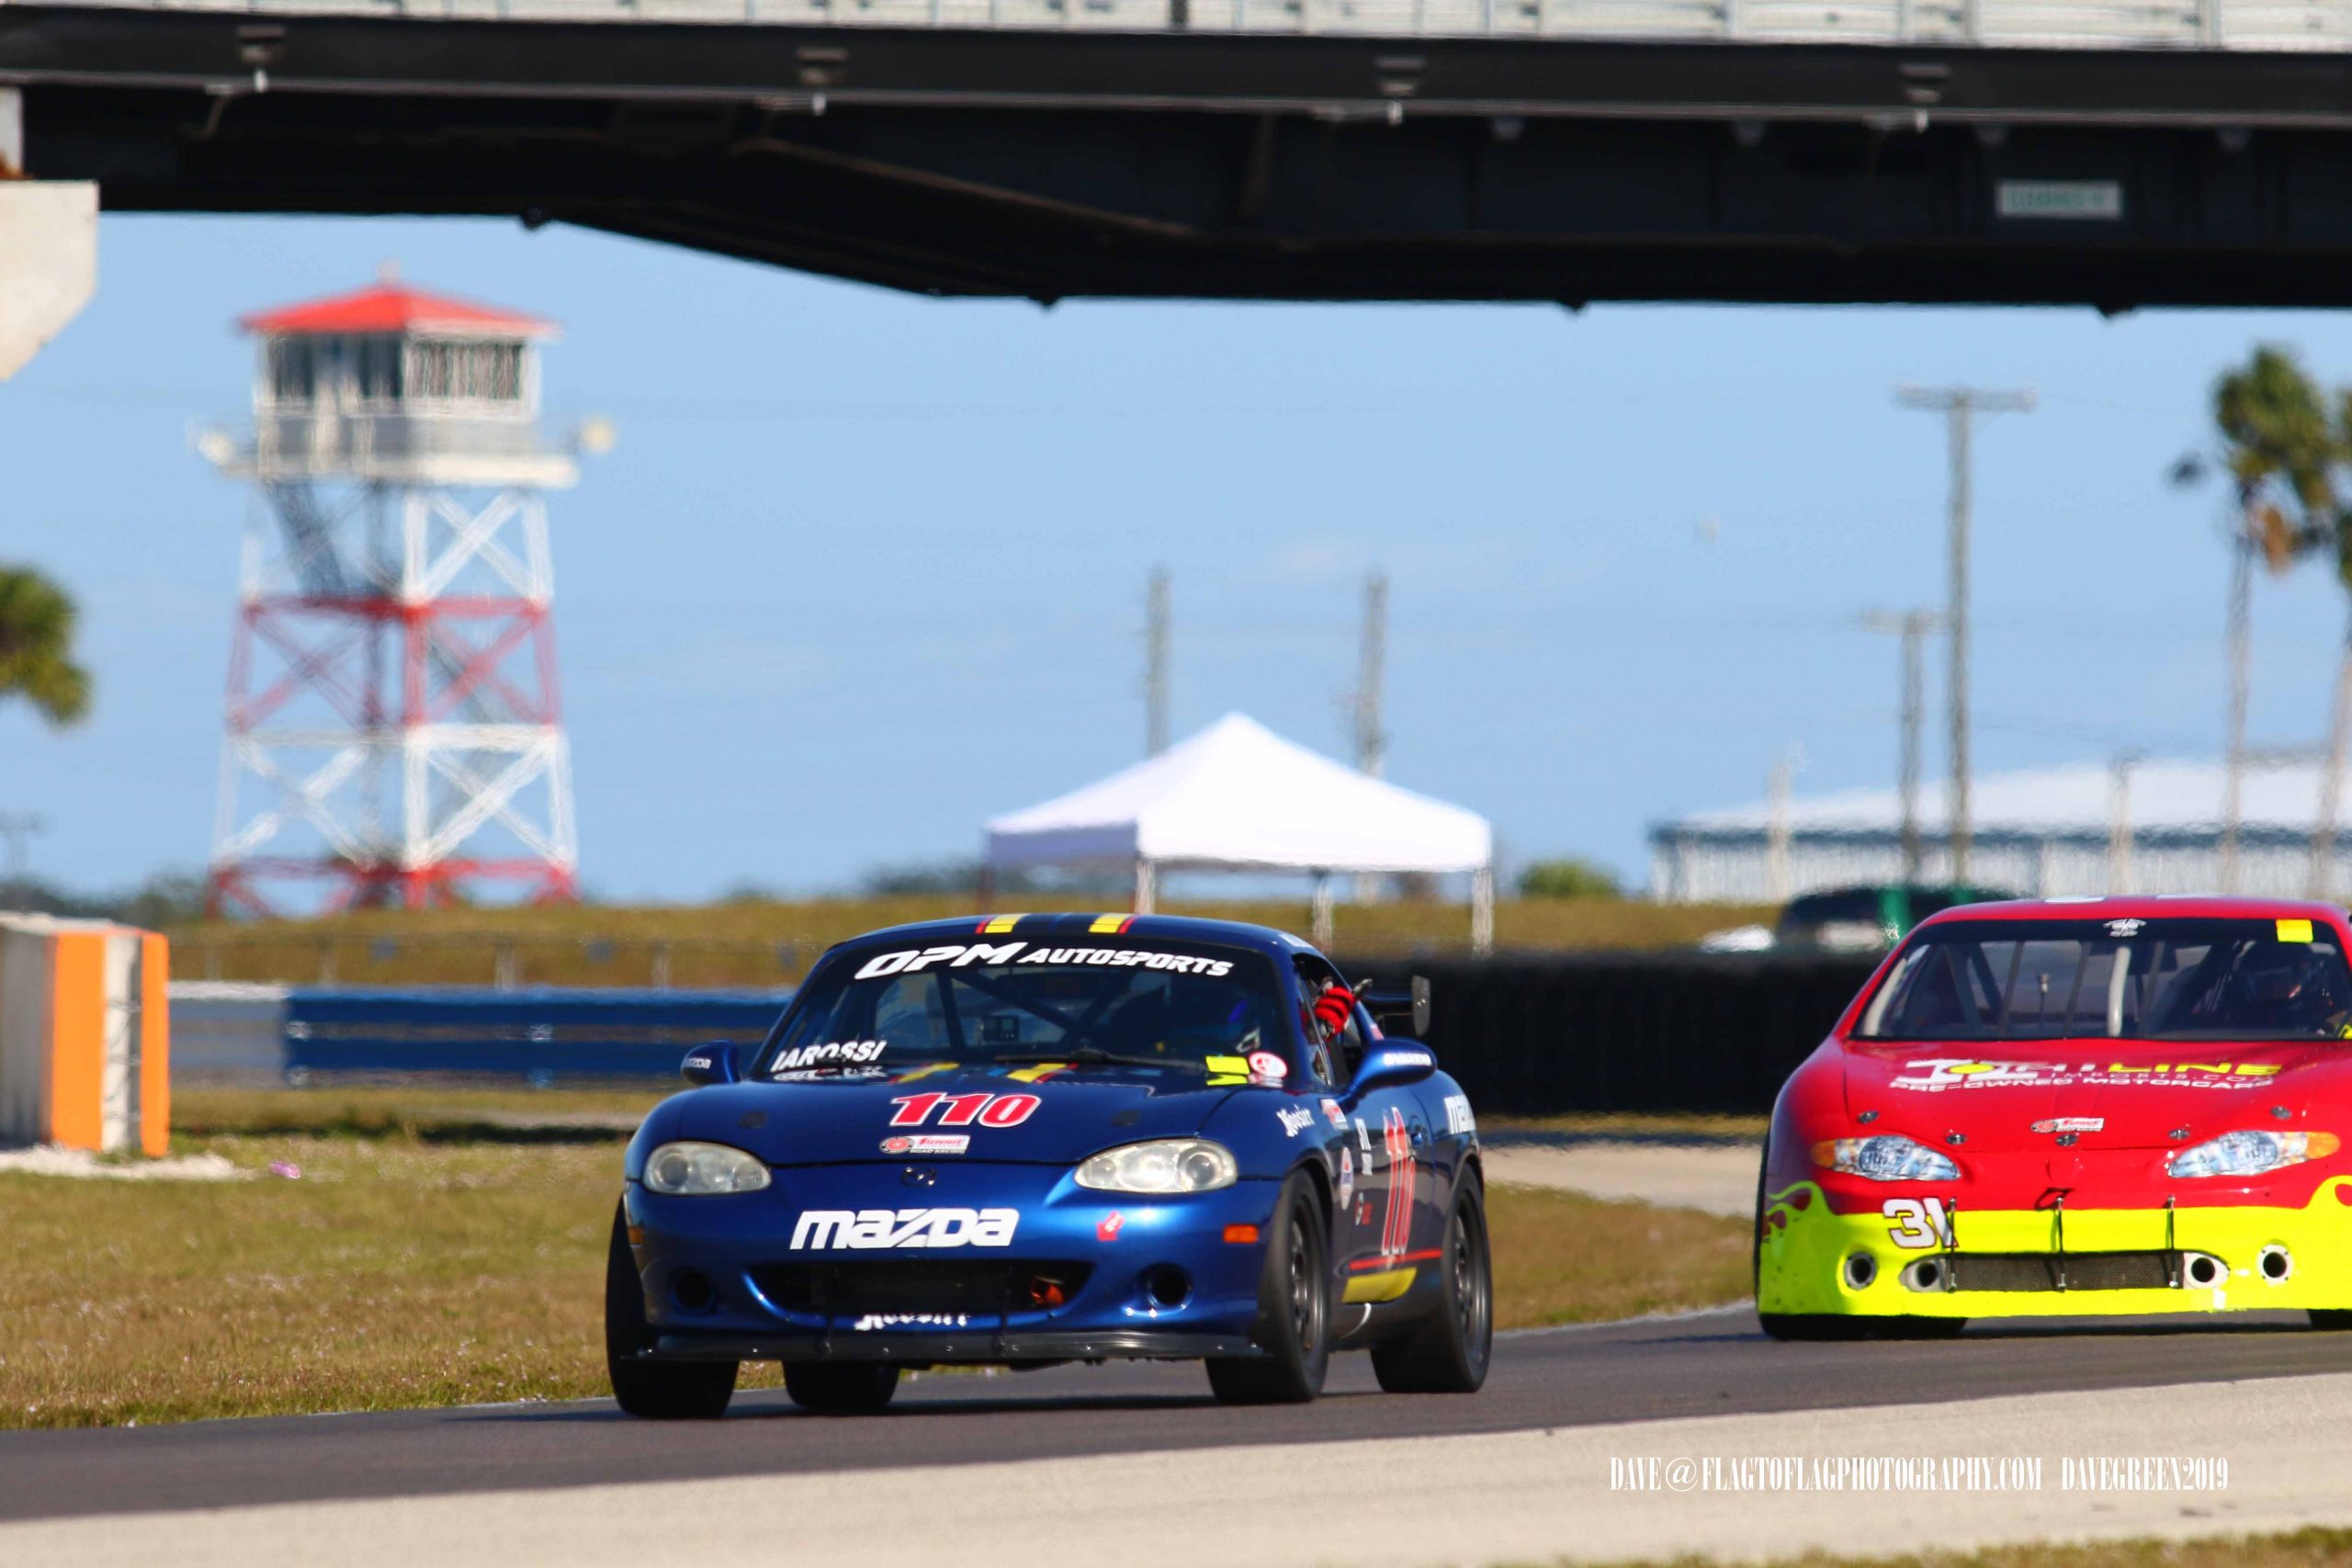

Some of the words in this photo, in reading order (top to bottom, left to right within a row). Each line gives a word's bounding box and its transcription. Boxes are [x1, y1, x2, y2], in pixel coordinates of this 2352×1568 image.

[854, 942, 1028, 980] OPM
[1016, 948, 1233, 976] AUTOSPORTS
[770, 1040, 888, 1072] IAROSSI
[2109, 1062, 2283, 1076] LINE
[889, 1091, 1042, 1128] 110
[1883, 1197, 1960, 1249] 31
